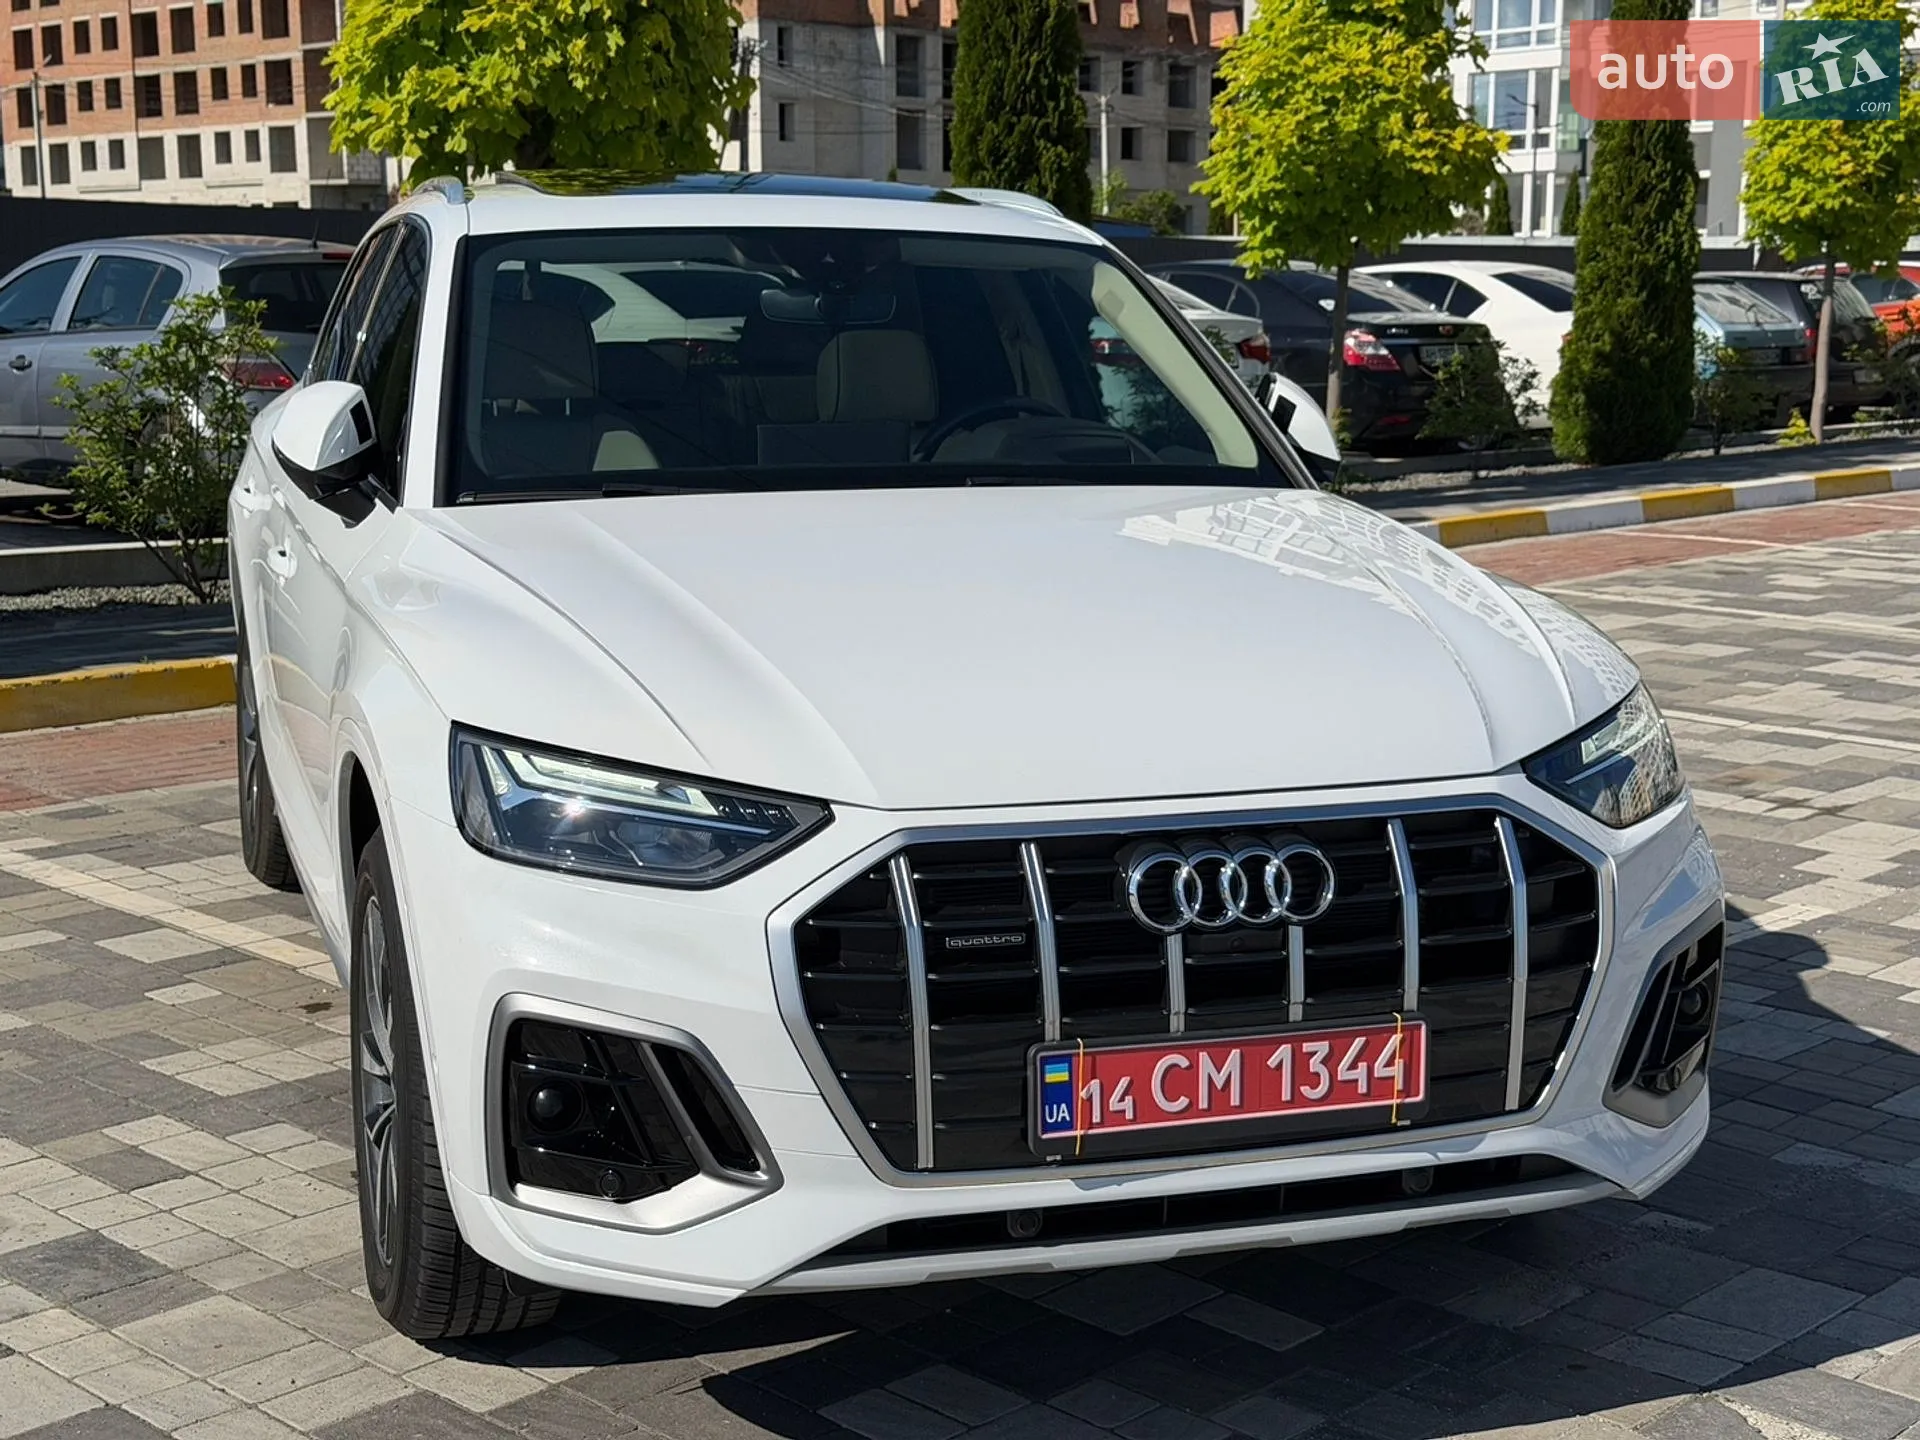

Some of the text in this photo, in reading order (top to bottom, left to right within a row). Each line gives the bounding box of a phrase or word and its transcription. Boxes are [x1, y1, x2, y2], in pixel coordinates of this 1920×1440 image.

[950, 935, 1022, 948] quattro
[1080, 1035, 1404, 1123] 14 CM 1344
[1045, 1103, 1070, 1123] UA
